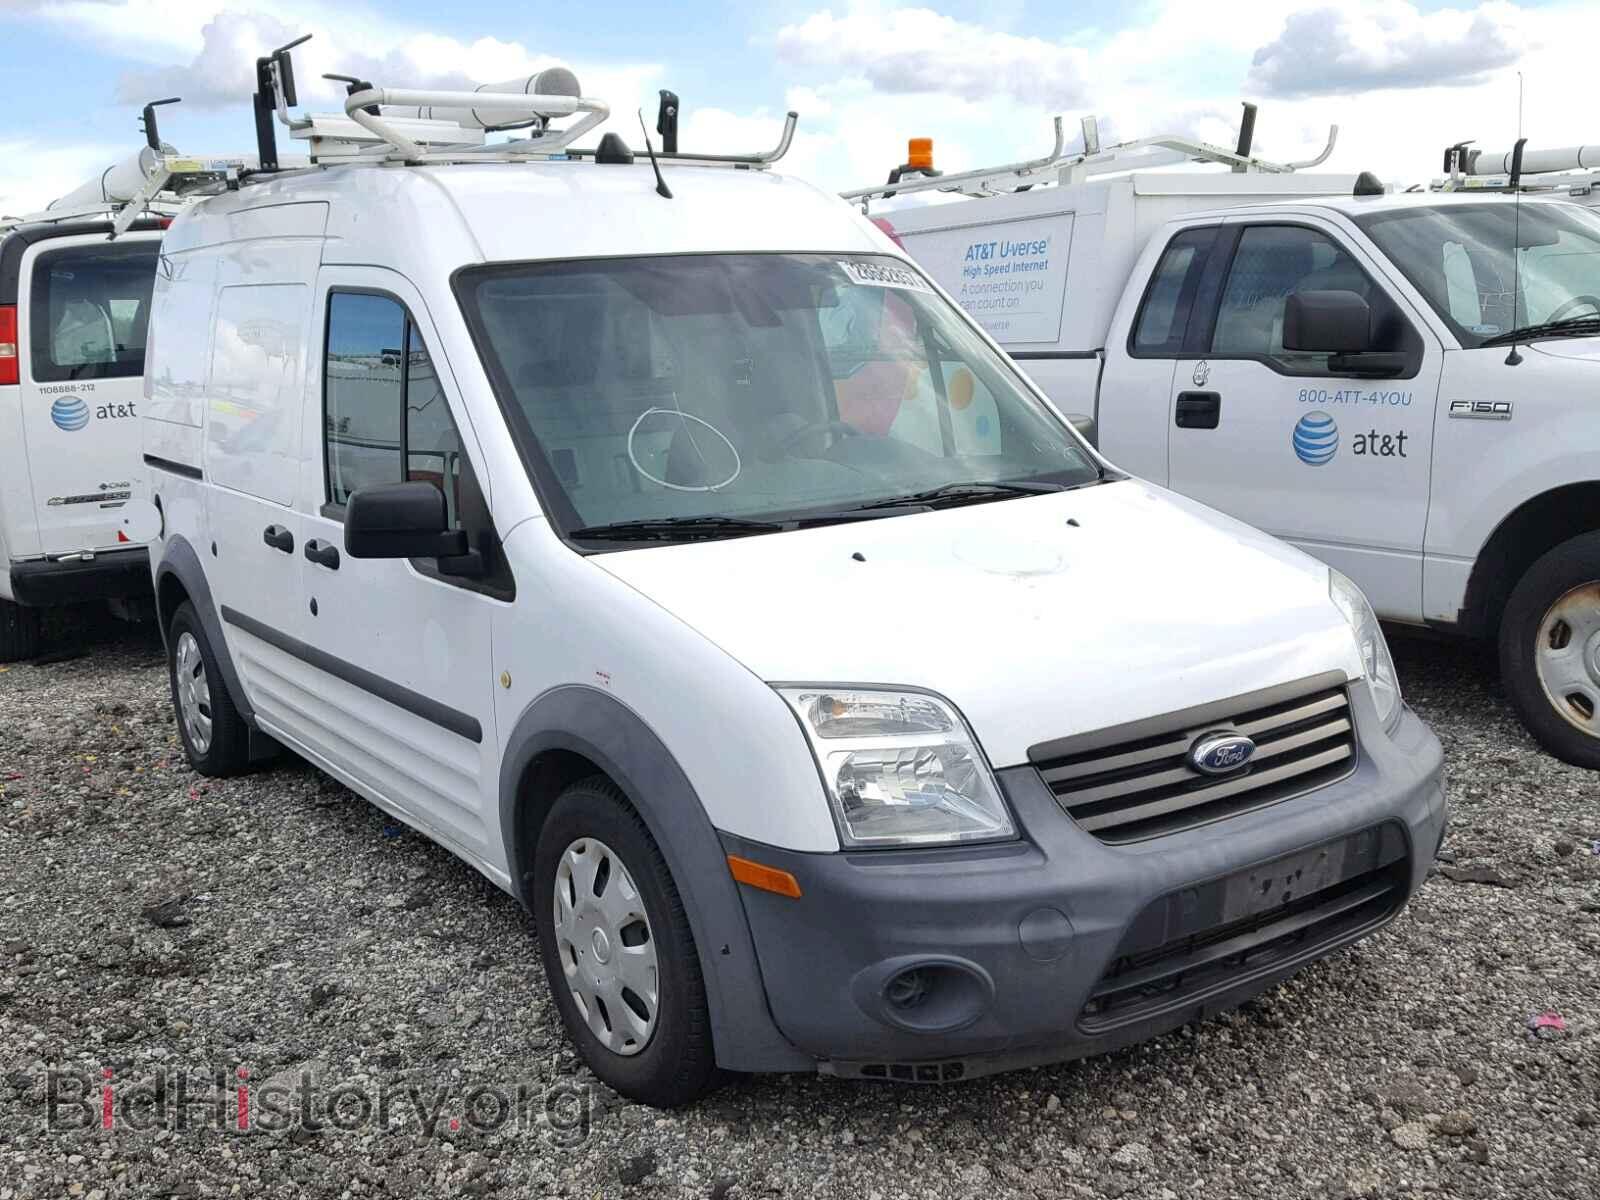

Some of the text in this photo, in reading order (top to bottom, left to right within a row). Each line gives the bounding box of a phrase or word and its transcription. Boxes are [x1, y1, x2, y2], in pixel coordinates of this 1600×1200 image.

[965, 242, 997, 261] AT&T
[963, 260, 1048, 279] High Speed Internet
[961, 279, 1044, 295] A connection you
[977, 298, 1005, 310] count
[1006, 297, 1020, 308] on
[1299, 389, 1412, 407] 800-ATT-4YOU
[96, 401, 137, 419] at&t
[1352, 429, 1408, 458] at&t
[1215, 744, 1245, 766] Ford
